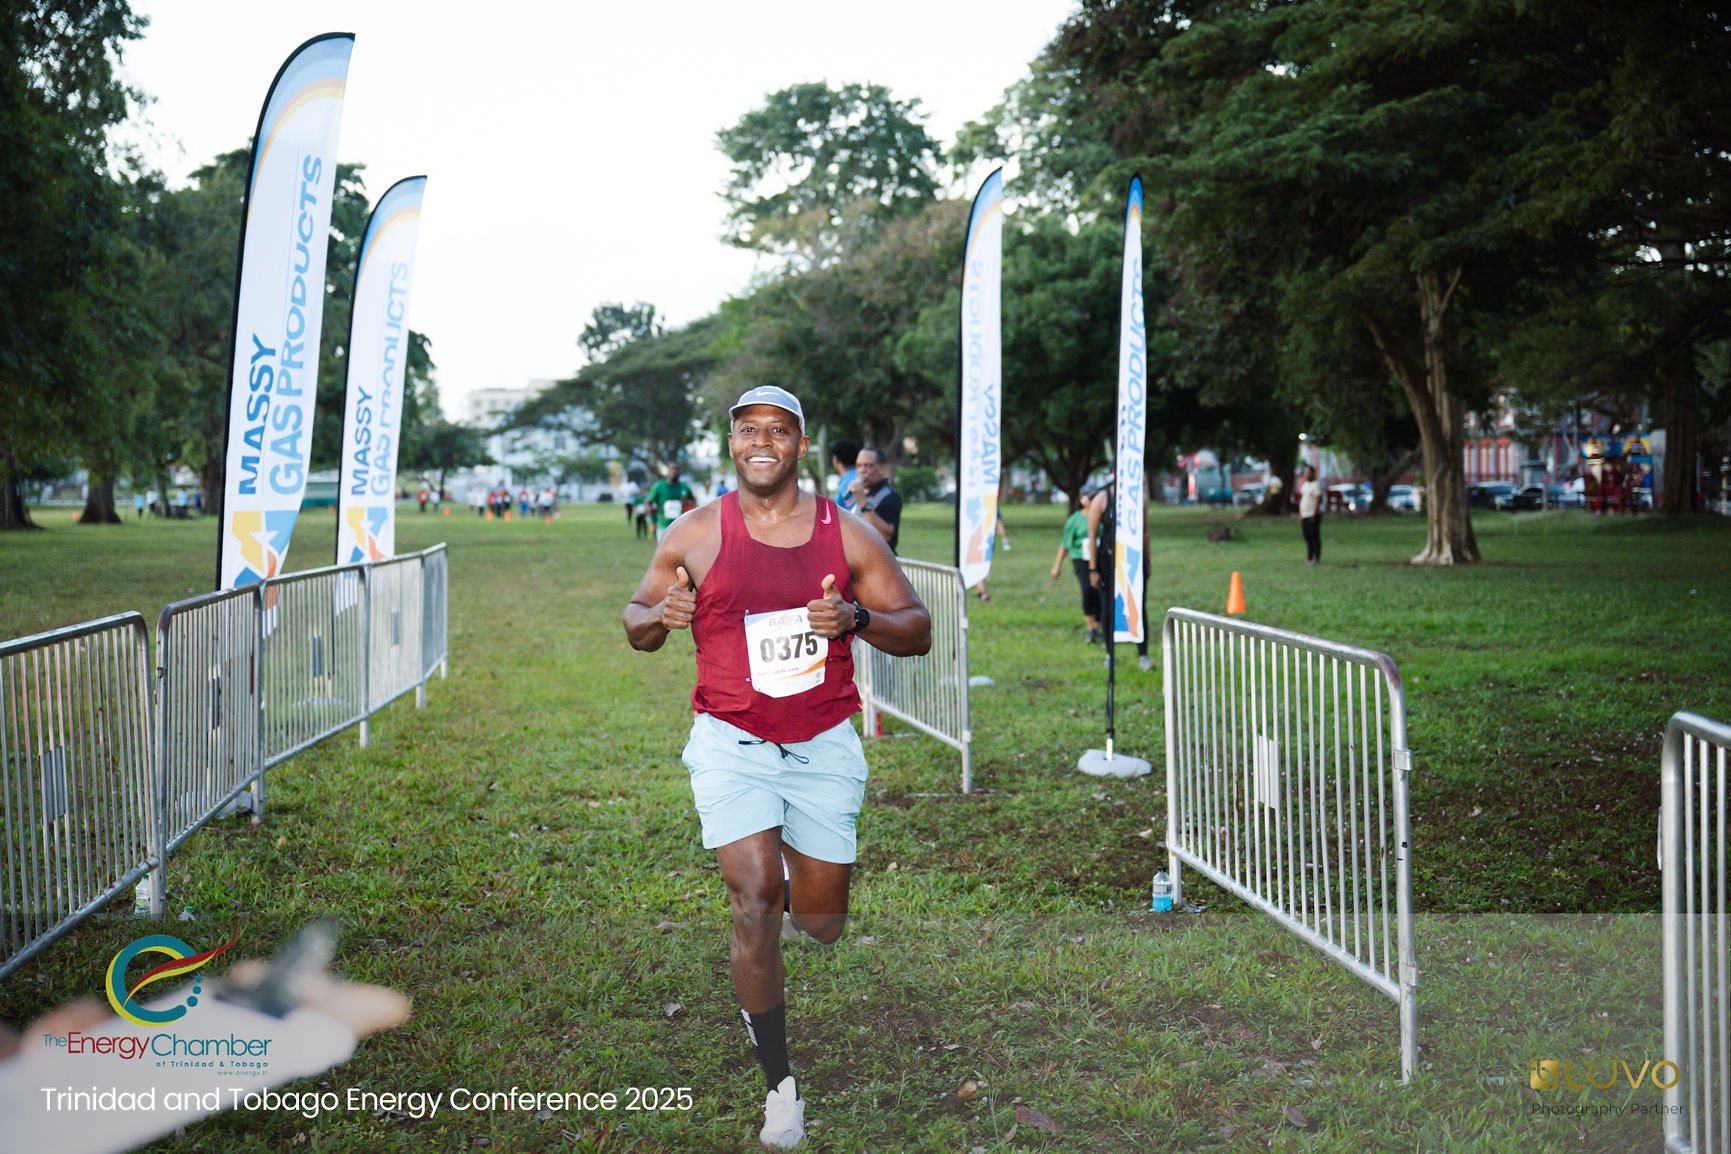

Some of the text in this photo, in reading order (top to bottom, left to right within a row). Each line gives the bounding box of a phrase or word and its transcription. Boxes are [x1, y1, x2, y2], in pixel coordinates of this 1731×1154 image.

[269, 154, 322, 495] GAS PRODUCTS
[238, 333, 276, 494] MASSY
[351, 385, 373, 495] MASSY
[760, 630, 818, 663] 0375
